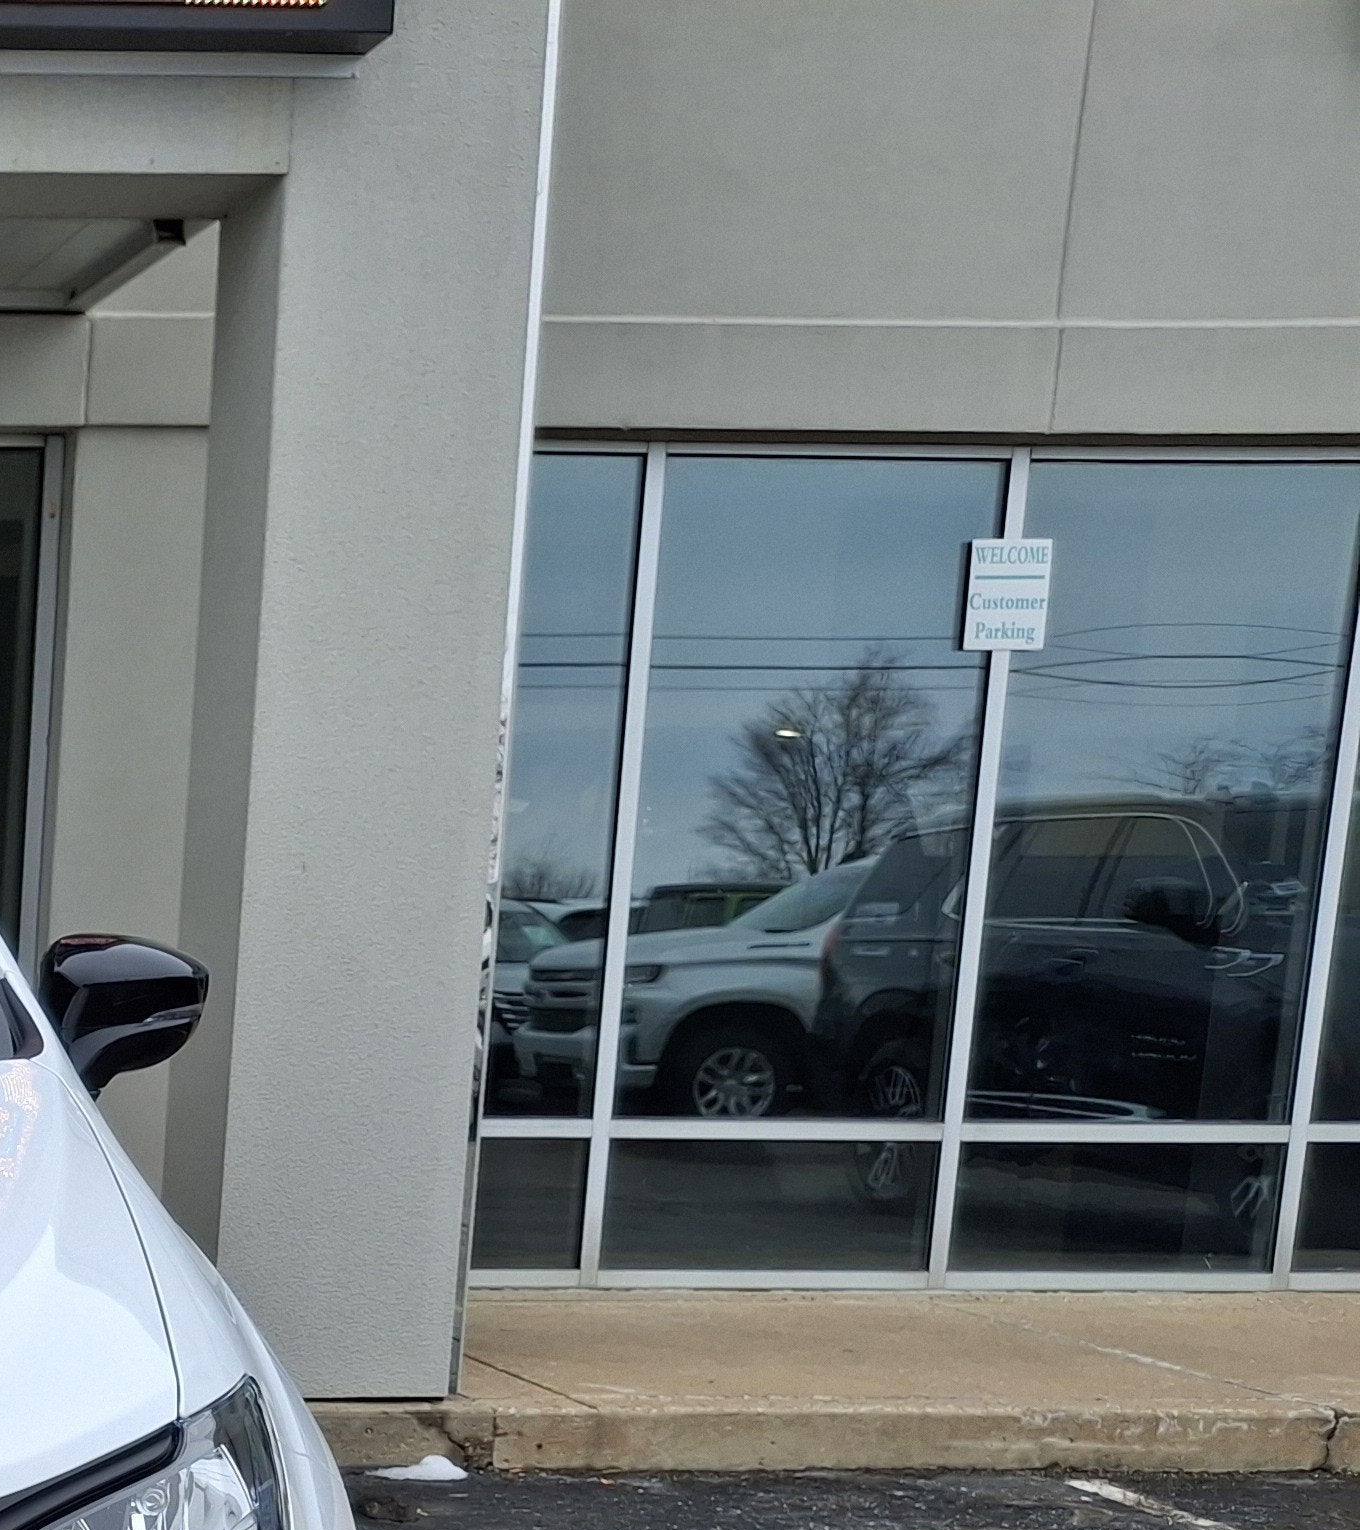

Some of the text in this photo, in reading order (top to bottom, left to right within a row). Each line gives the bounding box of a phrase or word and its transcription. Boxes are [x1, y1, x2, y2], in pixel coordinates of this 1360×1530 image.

[975, 546, 1050, 565] WELCOME
[969, 592, 1046, 611] Customer
[974, 621, 1036, 644] Parking
